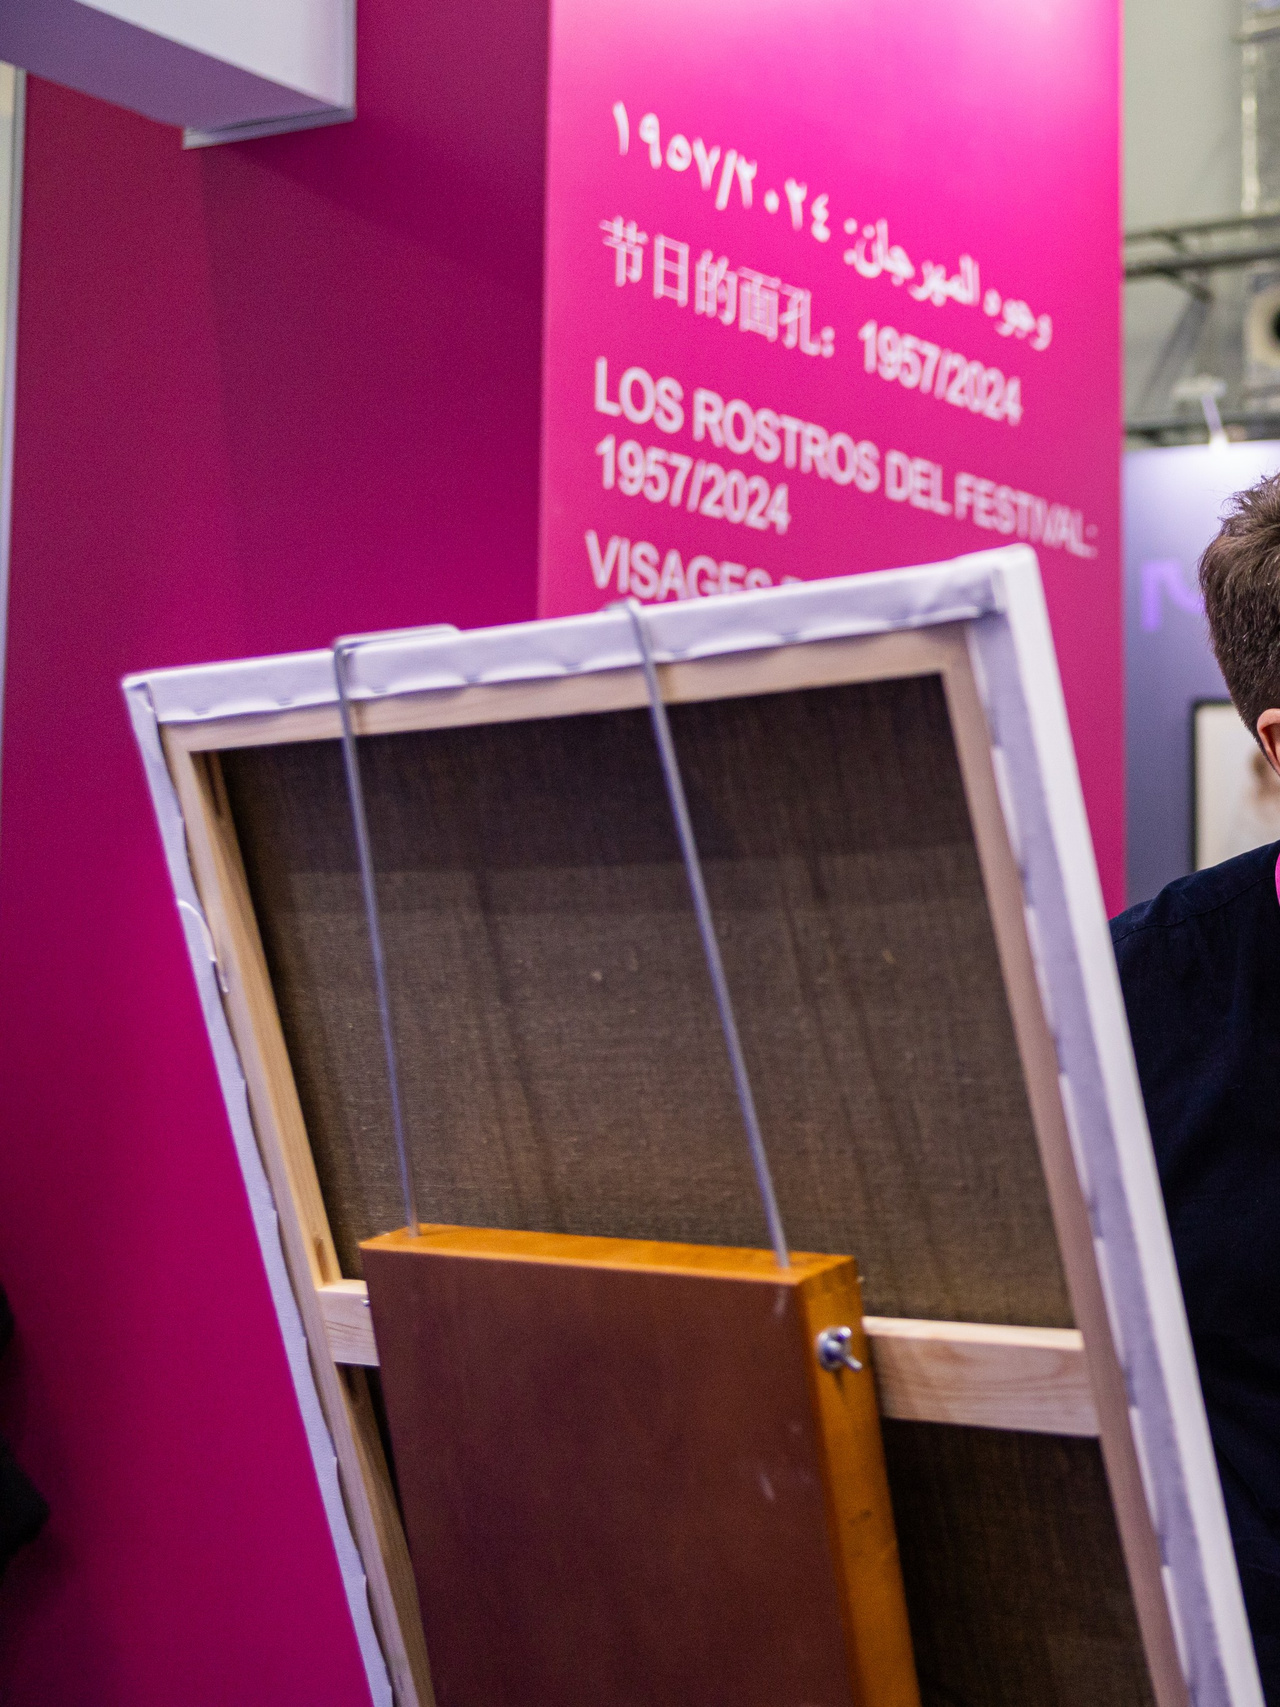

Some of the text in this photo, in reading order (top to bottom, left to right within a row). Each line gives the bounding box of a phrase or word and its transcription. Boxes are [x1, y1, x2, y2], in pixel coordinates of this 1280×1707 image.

[858, 319, 1022, 426] 1957/2024
[594, 355, 684, 435] LOS
[692, 387, 881, 494] ROSTROS
[885, 450, 953, 517] DEL
[596, 433, 792, 536] 1957/2024
